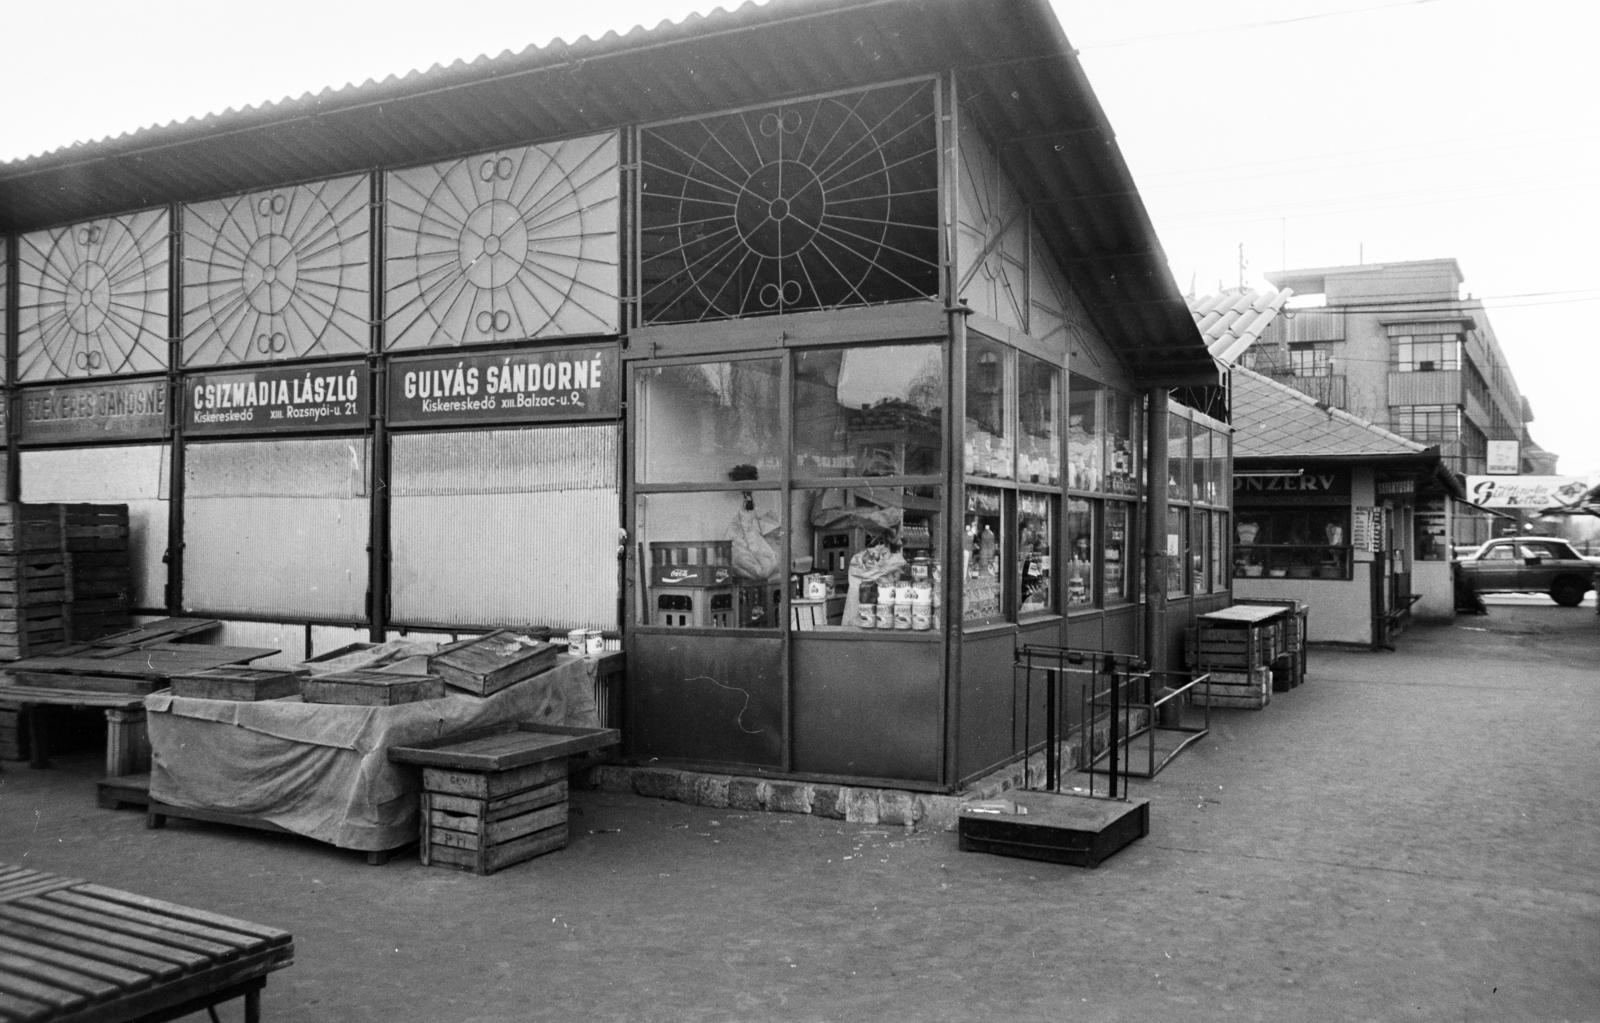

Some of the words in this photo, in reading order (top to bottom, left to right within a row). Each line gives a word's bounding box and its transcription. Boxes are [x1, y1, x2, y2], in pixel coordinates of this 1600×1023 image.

[194, 380, 289, 410] CSIZMADIA
[293, 369, 358, 404] LÁSZLÓ
[404, 361, 479, 399] GULYÁS
[486, 352, 601, 394] SÁNDORNÉ
[194, 407, 253, 424] Kiskereskedő
[422, 395, 496, 412] Kiskereskedő
